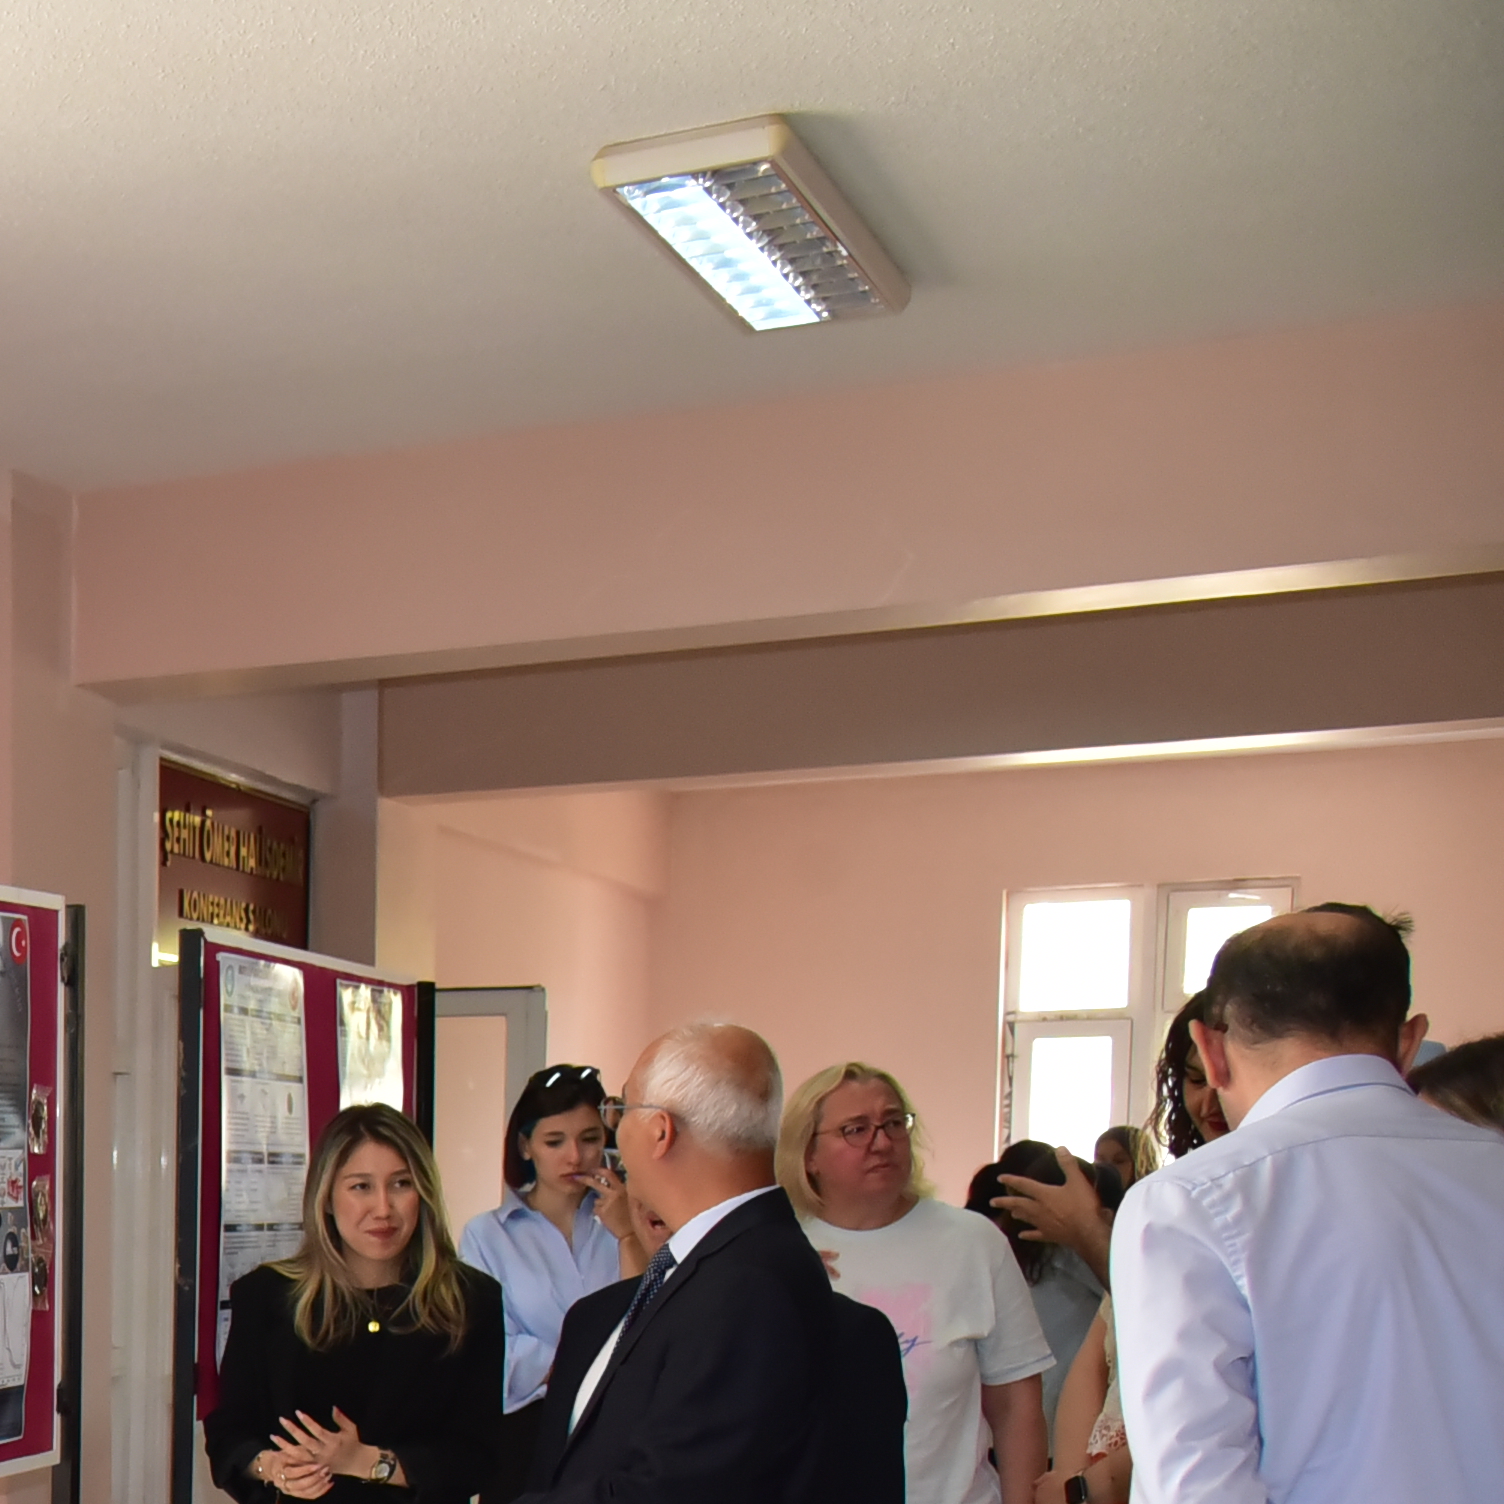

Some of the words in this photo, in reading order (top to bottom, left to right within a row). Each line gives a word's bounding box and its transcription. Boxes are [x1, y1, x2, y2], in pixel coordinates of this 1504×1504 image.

[165, 810, 202, 867] ŞEHİT
[203, 809, 238, 869] ÖMER
[183, 888, 246, 931] KONFERANS
